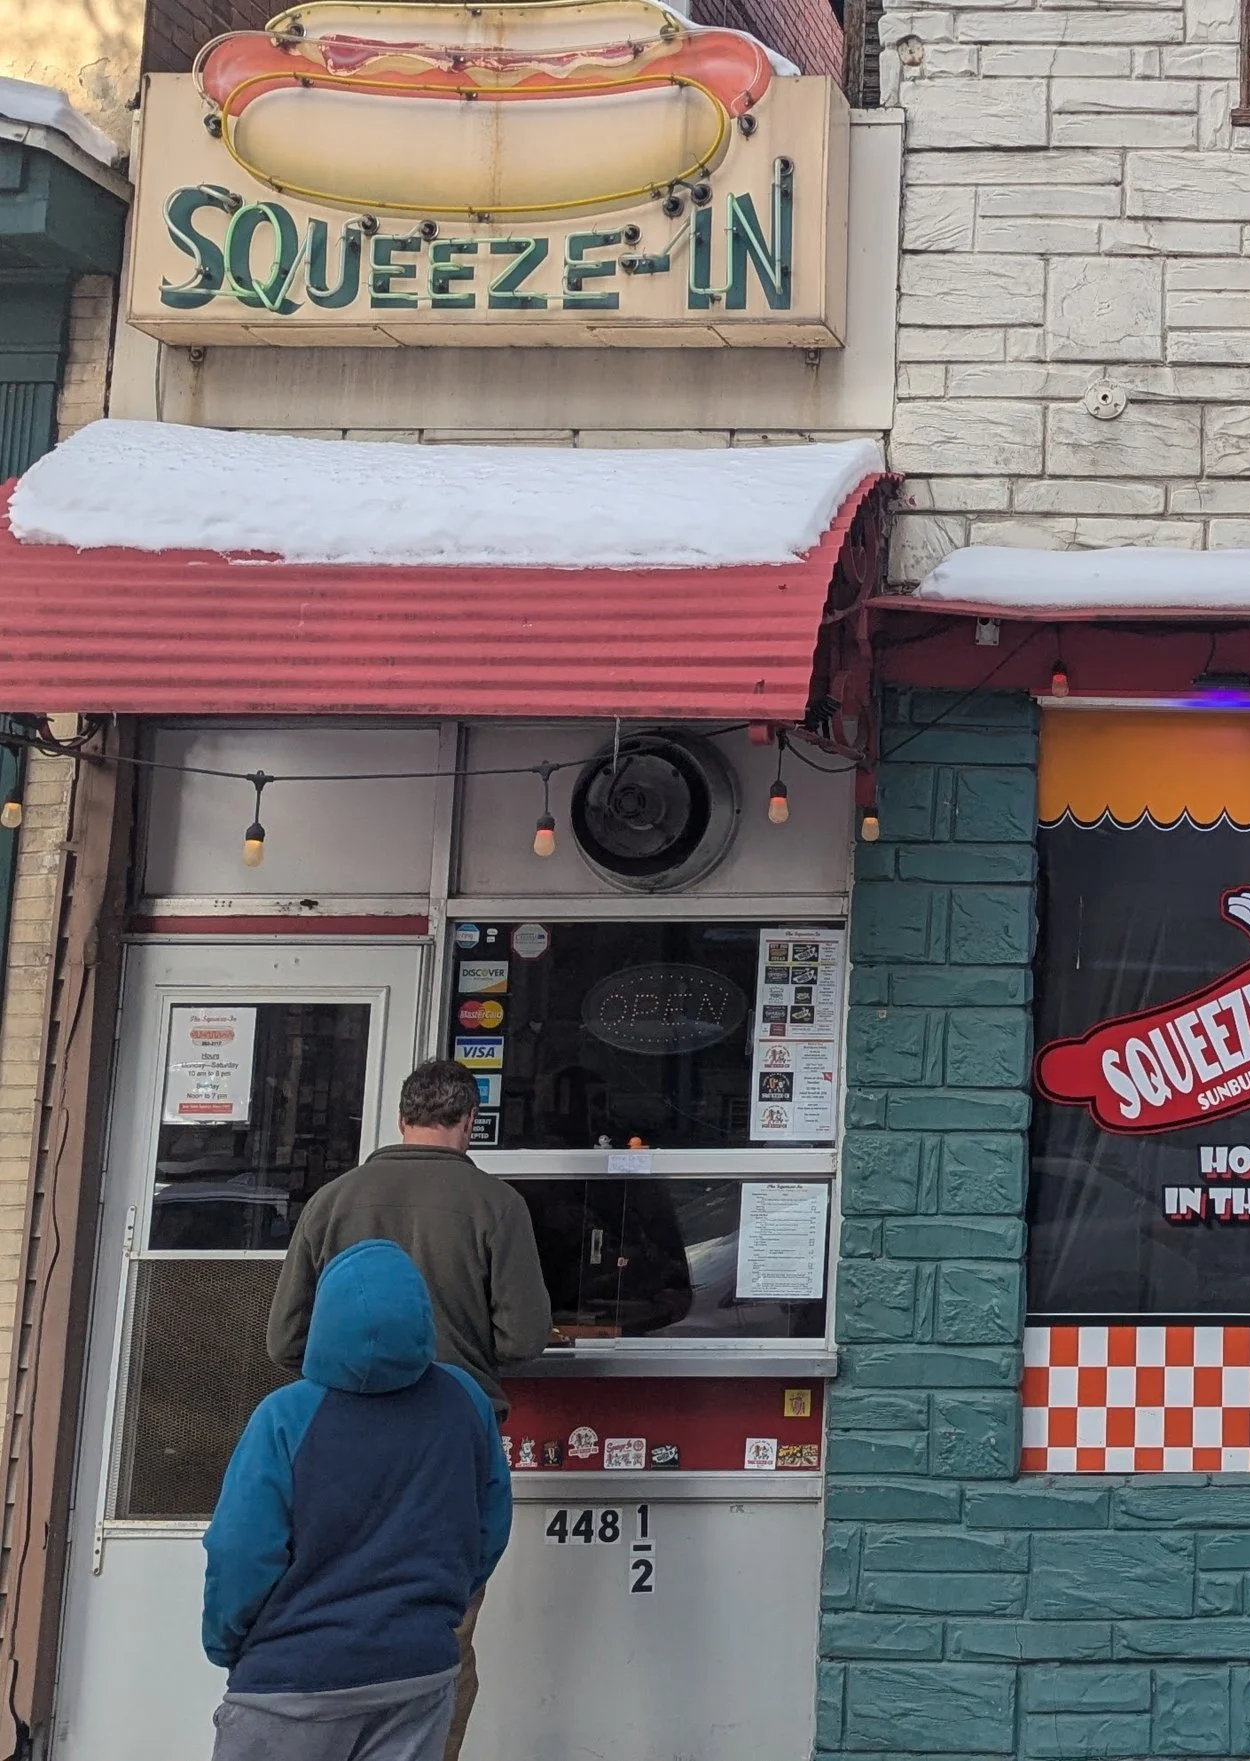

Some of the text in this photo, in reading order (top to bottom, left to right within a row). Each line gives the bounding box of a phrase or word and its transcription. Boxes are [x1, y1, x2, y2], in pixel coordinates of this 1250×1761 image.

[160, 157, 793, 314] SQUEEZE-IN
[462, 968, 505, 977] DISCOVER
[460, 1009, 502, 1018] MasterCard
[600, 992, 729, 1027] OPEN
[463, 1046, 496, 1058] VISA
[220, 1071, 231, 1079] pm
[1163, 1187, 1202, 1215] IN
[546, 1504, 649, 1544] 448 1
[631, 1558, 653, 1593] 2
